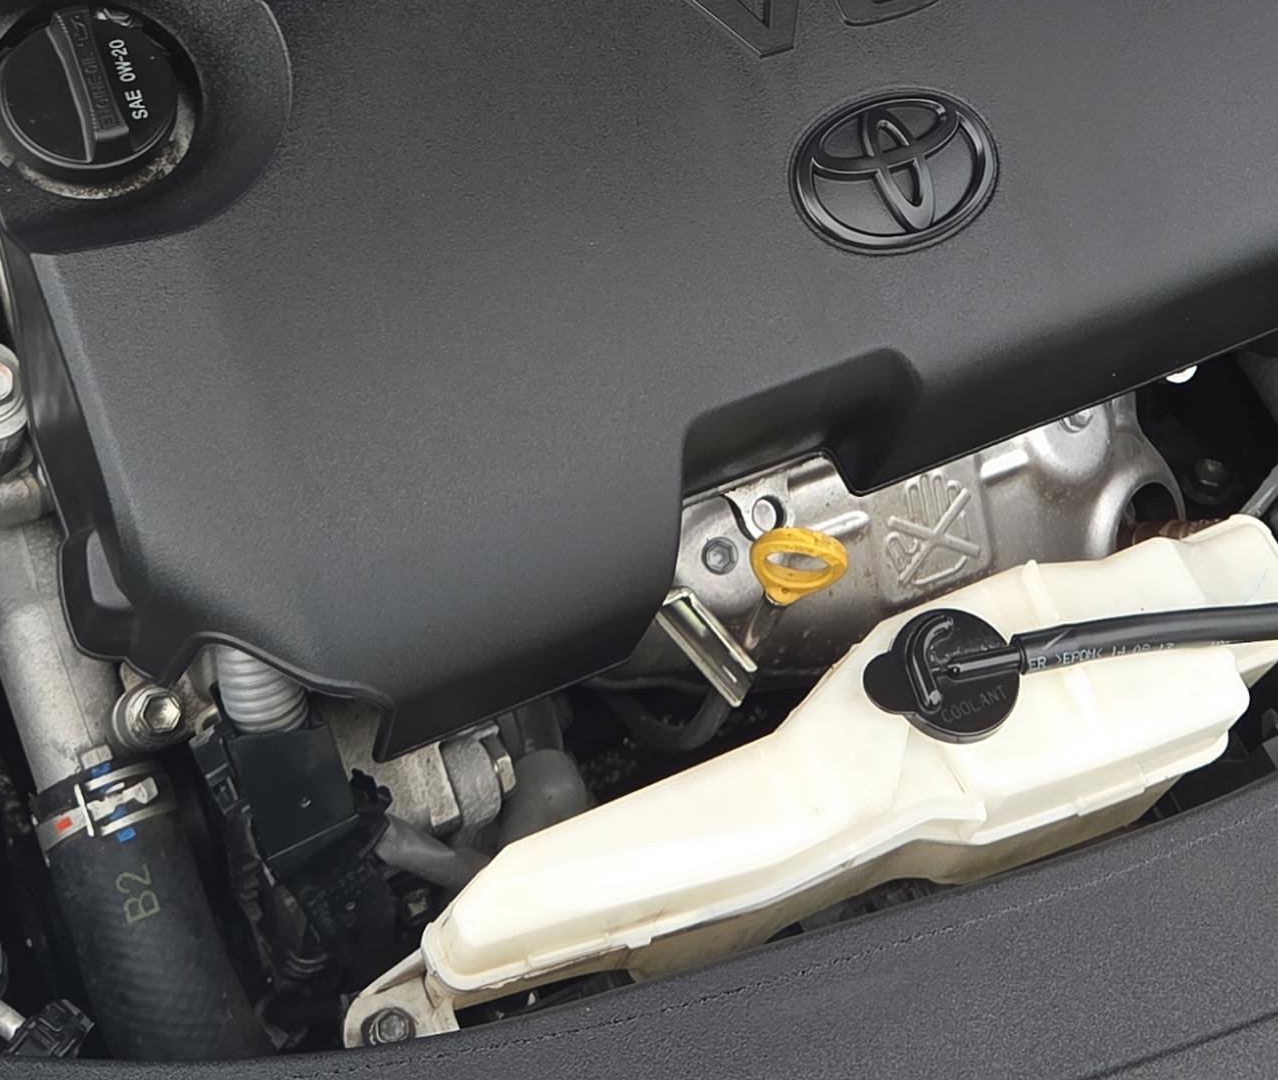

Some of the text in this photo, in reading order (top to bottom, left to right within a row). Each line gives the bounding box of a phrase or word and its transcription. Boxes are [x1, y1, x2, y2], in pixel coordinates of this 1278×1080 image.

[108, 39, 149, 120] SAE 0W-20
[940, 684, 1008, 724] COOLANT
[116, 863, 162, 925] B2
